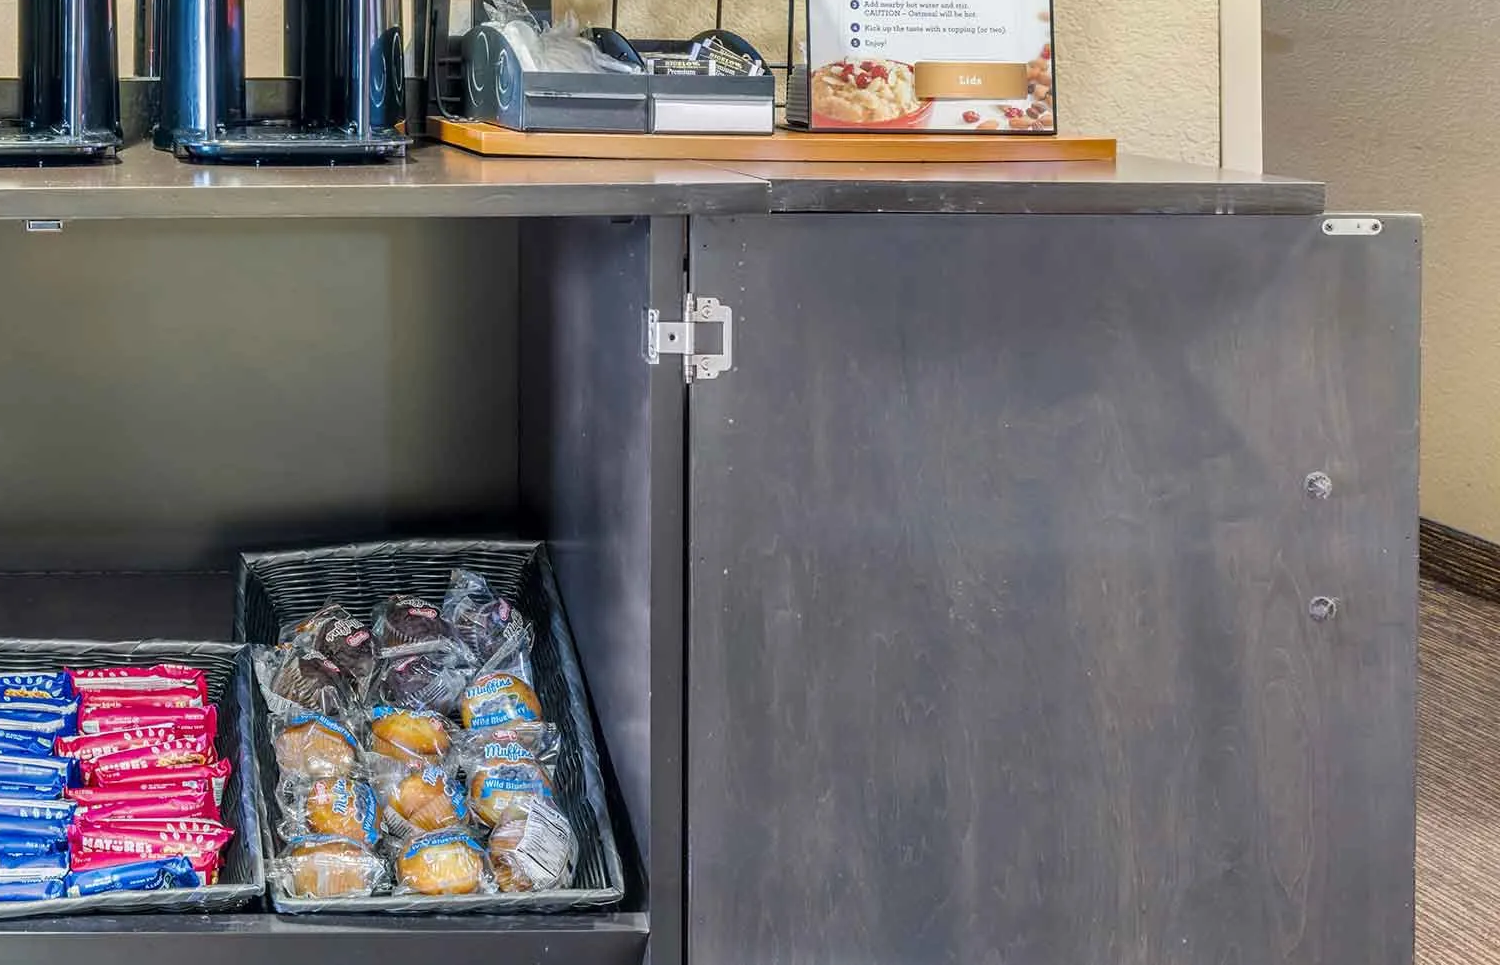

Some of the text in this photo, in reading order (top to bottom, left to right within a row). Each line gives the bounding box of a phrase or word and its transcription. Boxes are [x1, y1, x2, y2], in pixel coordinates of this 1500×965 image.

[881, 1, 904, 10] nearby
[864, 9, 900, 17] CAUTION
[908, 10, 939, 18] Oatmeal
[864, 24, 880, 32] Kick
[959, 75, 982, 86] Lids
[466, 677, 514, 699] Muffins
[471, 716, 490, 727] Wild
[485, 742, 534, 761] Muffins
[485, 780, 504, 789] Wild
